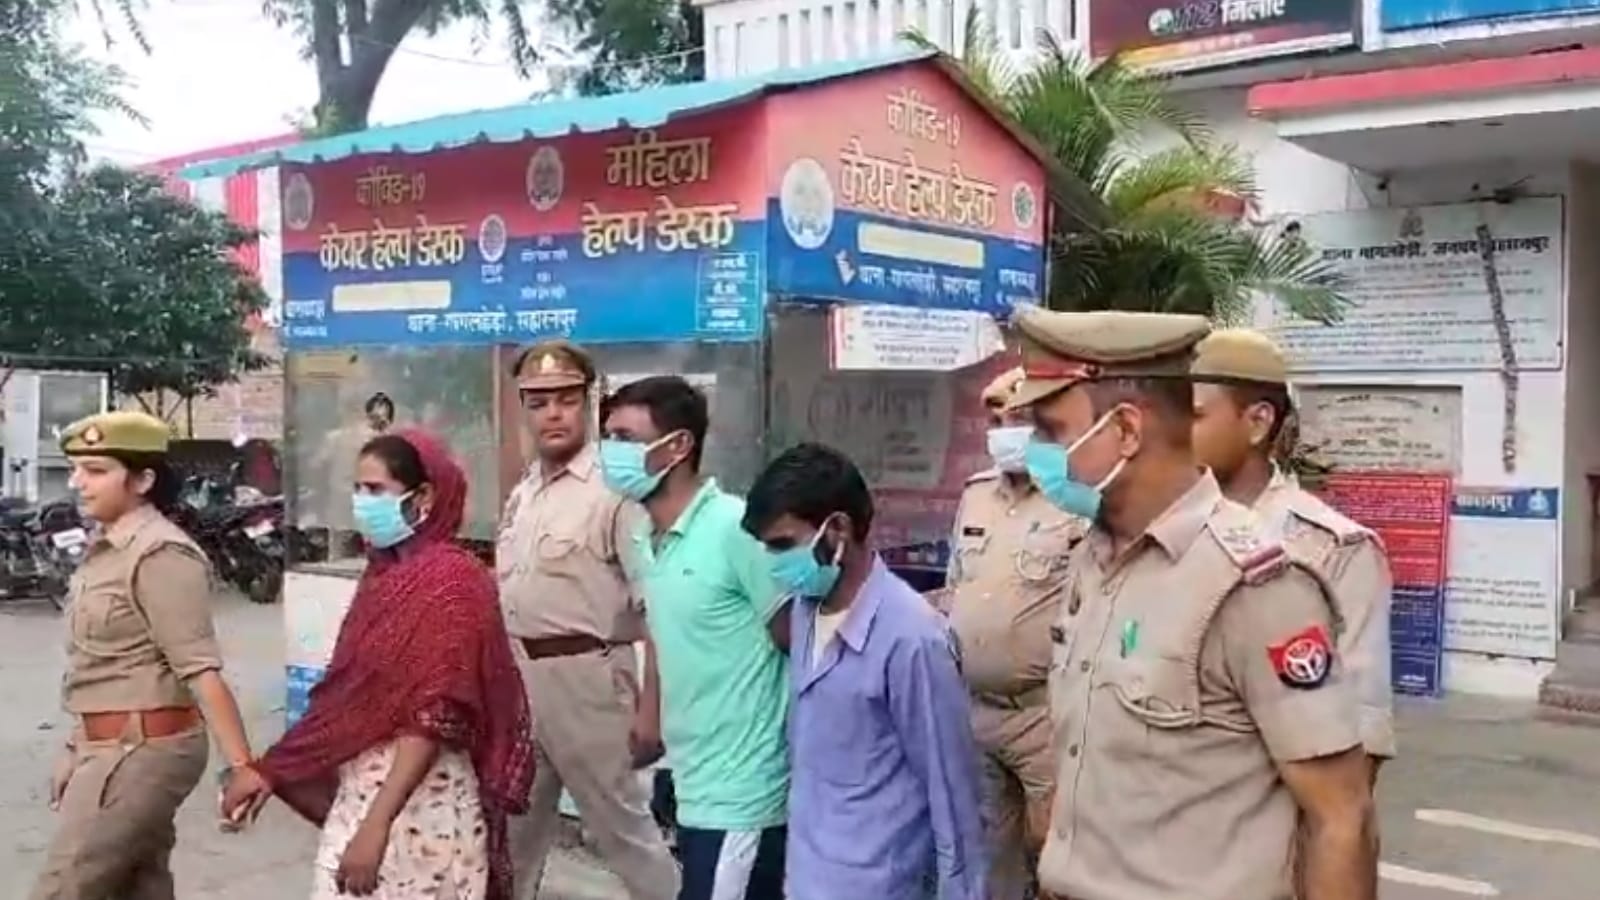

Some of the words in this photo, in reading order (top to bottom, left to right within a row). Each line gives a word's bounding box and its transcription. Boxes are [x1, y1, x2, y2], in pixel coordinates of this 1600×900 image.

[356, 164, 427, 208] कोविड-19
[605, 129, 713, 188] महिला
[840, 137, 901, 212] केयर
[902, 150, 948, 219] हेल्प
[951, 163, 999, 228] डेस्क
[319, 221, 370, 272] केयर
[371, 217, 412, 270] हेल्प
[415, 213, 468, 267] डेस्क
[581, 201, 649, 259] हेल्प
[655, 194, 739, 252] डेस्क
